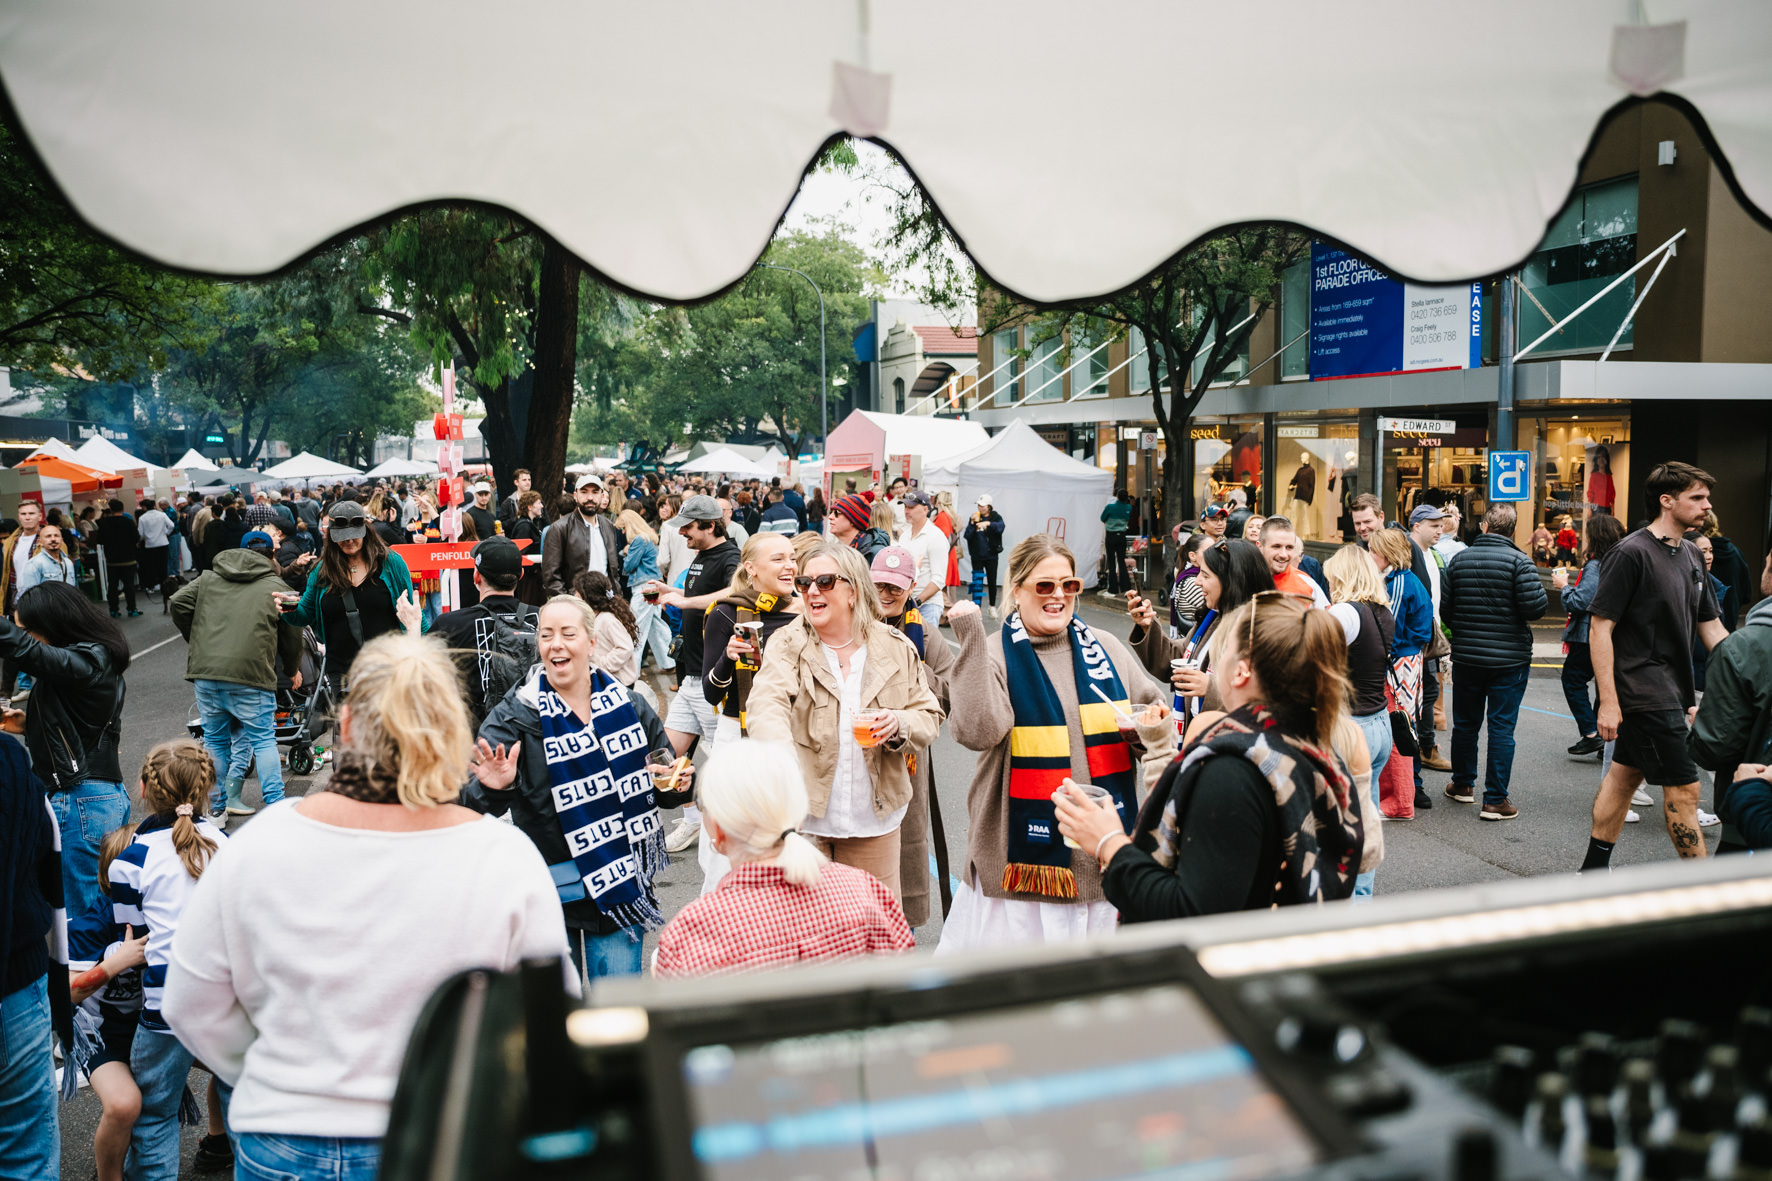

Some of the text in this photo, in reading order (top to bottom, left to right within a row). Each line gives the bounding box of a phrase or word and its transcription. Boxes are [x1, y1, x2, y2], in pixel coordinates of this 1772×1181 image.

[1316, 265, 1328, 278] 1st
[1329, 259, 1358, 276] FLOOR
[1315, 273, 1350, 292] PARADE
[1318, 305, 1331, 313] Areas
[1331, 303, 1342, 311] from
[1411, 309, 1427, 320] 0420
[1429, 306, 1442, 318] 736
[1318, 314, 1364, 327] Available immediately
[1318, 328, 1368, 343] Signage rights available
[1411, 325, 1424, 333] Craig
[1411, 330, 1456, 346] 0400 506 788
[1325, 347, 1340, 355] access
[1190, 425, 1220, 440] seed
[1403, 420, 1441, 431] EDWARD
[1543, 500, 1599, 512] hop little bunny
[545, 732, 595, 760] CATS
[558, 774, 613, 807] CATS
[574, 816, 626, 852] CATS
[1033, 825, 1050, 834] RAA
